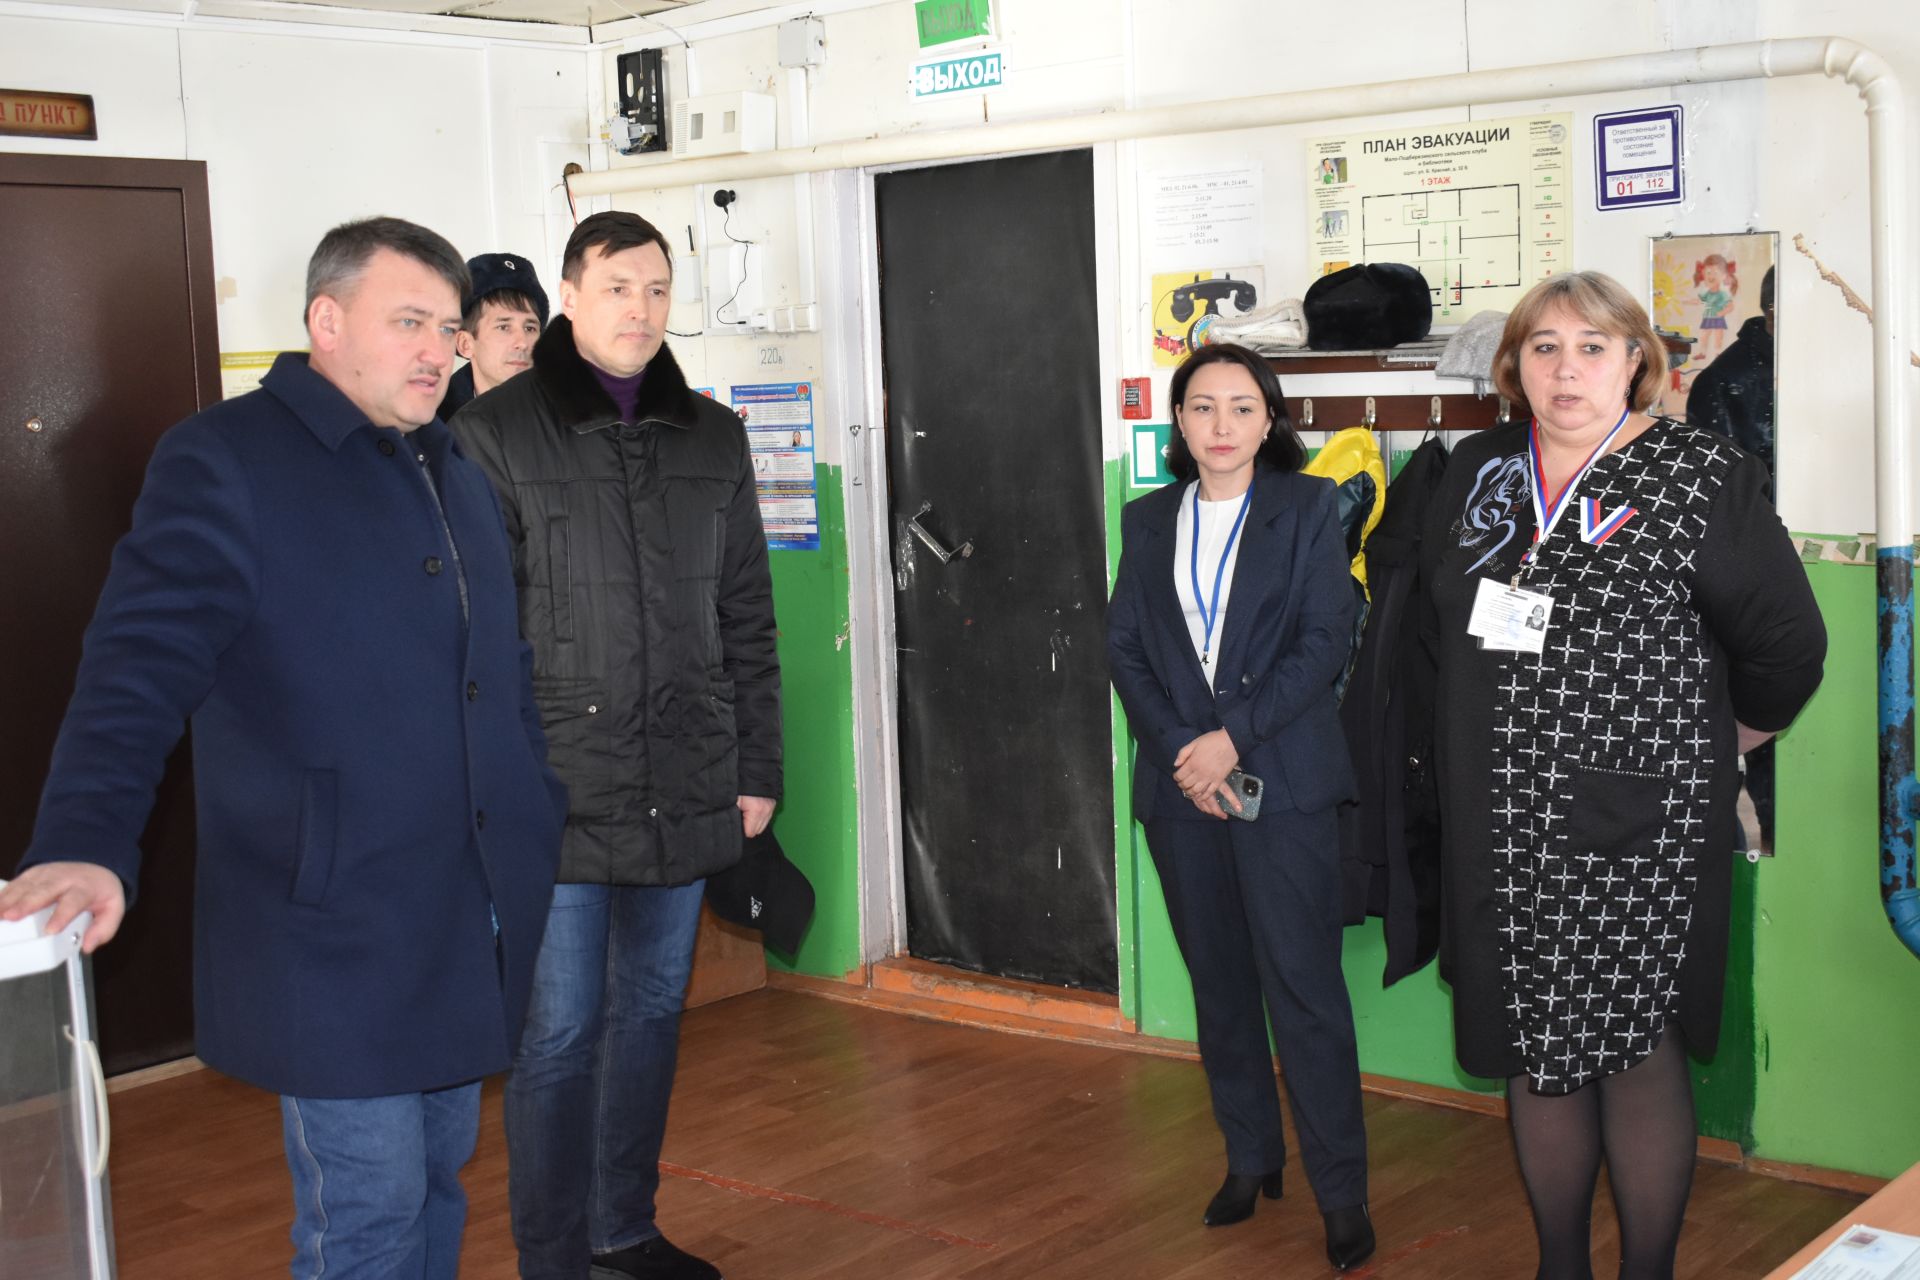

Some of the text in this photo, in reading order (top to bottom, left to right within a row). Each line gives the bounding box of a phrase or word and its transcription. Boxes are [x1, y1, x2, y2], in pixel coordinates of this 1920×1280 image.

[919, 57, 1000, 94] ВЫХОД
[15, 103, 77, 125] ПУНКТ
[1612, 126, 1658, 136] Ответственный
[1362, 137, 1407, 155] ПЛАН
[1411, 127, 1511, 150] ЭВАКУАЦИИ
[1613, 133, 1666, 144] противопожарное
[1622, 142, 1654, 150] состояние
[1622, 149, 1657, 158] помещения
[1421, 176, 1451, 186] 1 ЭТАЖ
[1616, 177, 1664, 196] 01 112
